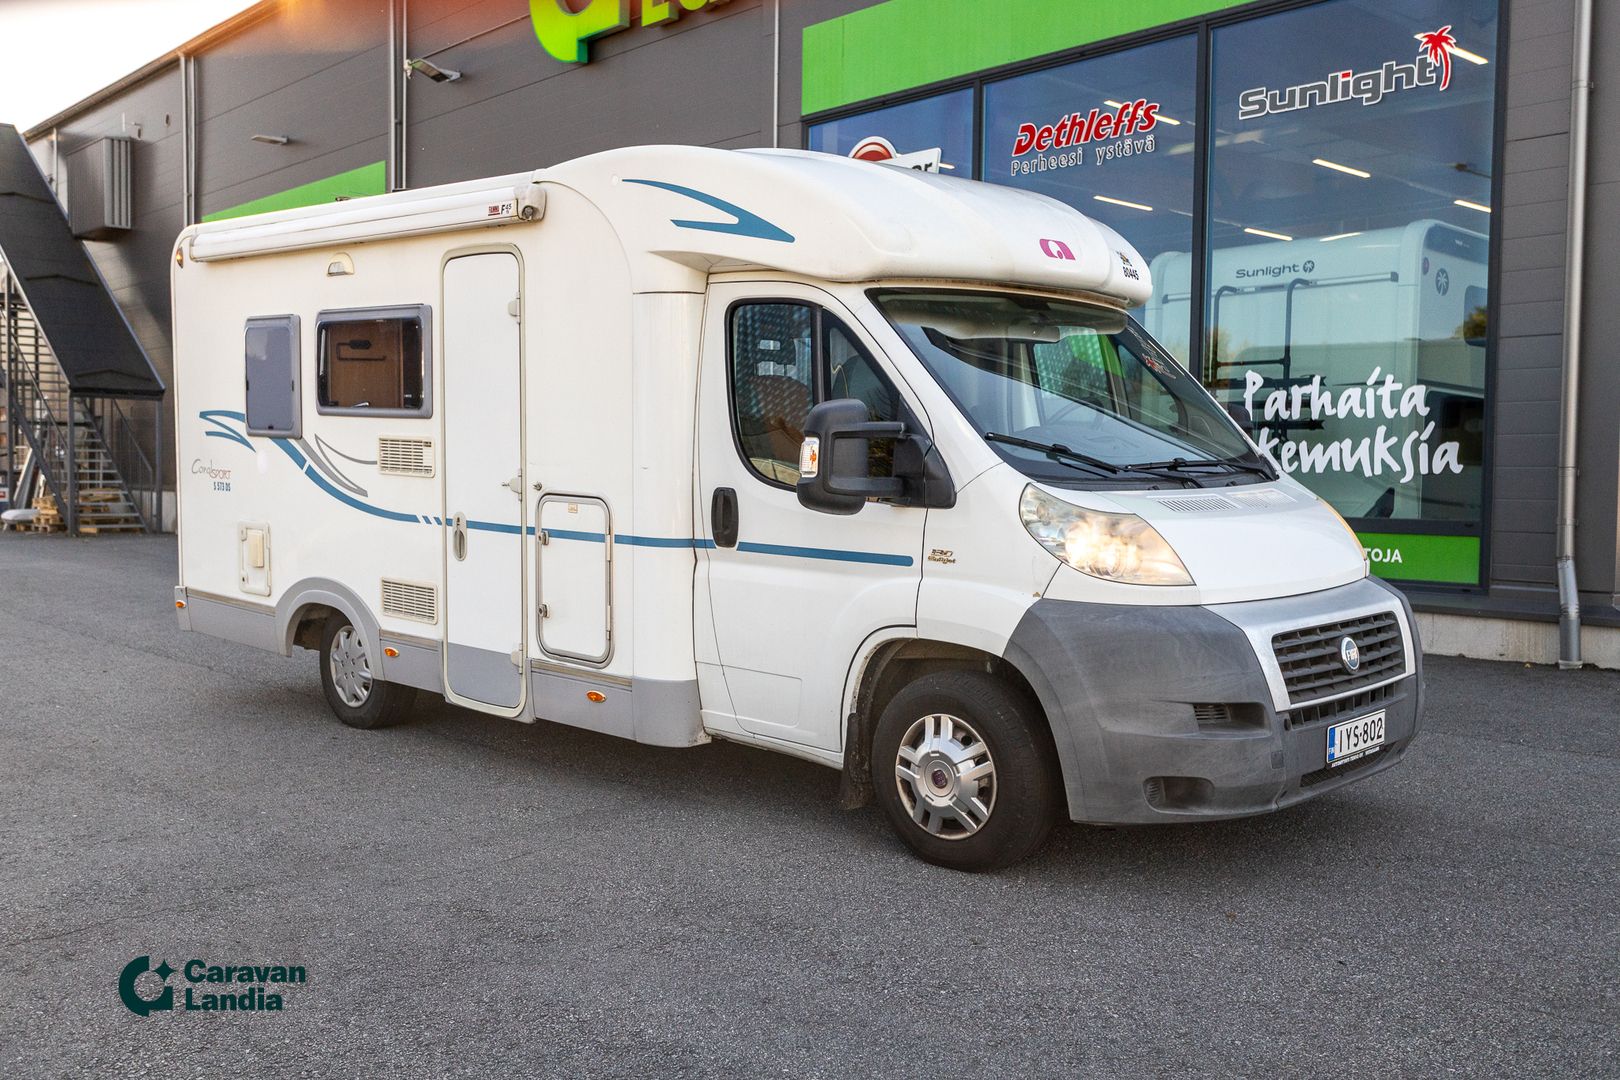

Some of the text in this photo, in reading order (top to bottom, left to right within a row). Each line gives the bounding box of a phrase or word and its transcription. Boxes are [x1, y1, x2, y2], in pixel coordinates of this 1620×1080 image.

[1239, 55, 1436, 120] Sunlight
[1012, 98, 1160, 157] Dethleffs
[1011, 134, 1156, 176] Perheesi ystävä
[1235, 263, 1300, 279] Sunlight
[1243, 366, 1431, 421] Parhaita
[1339, 717, 1383, 753] IYS-802
